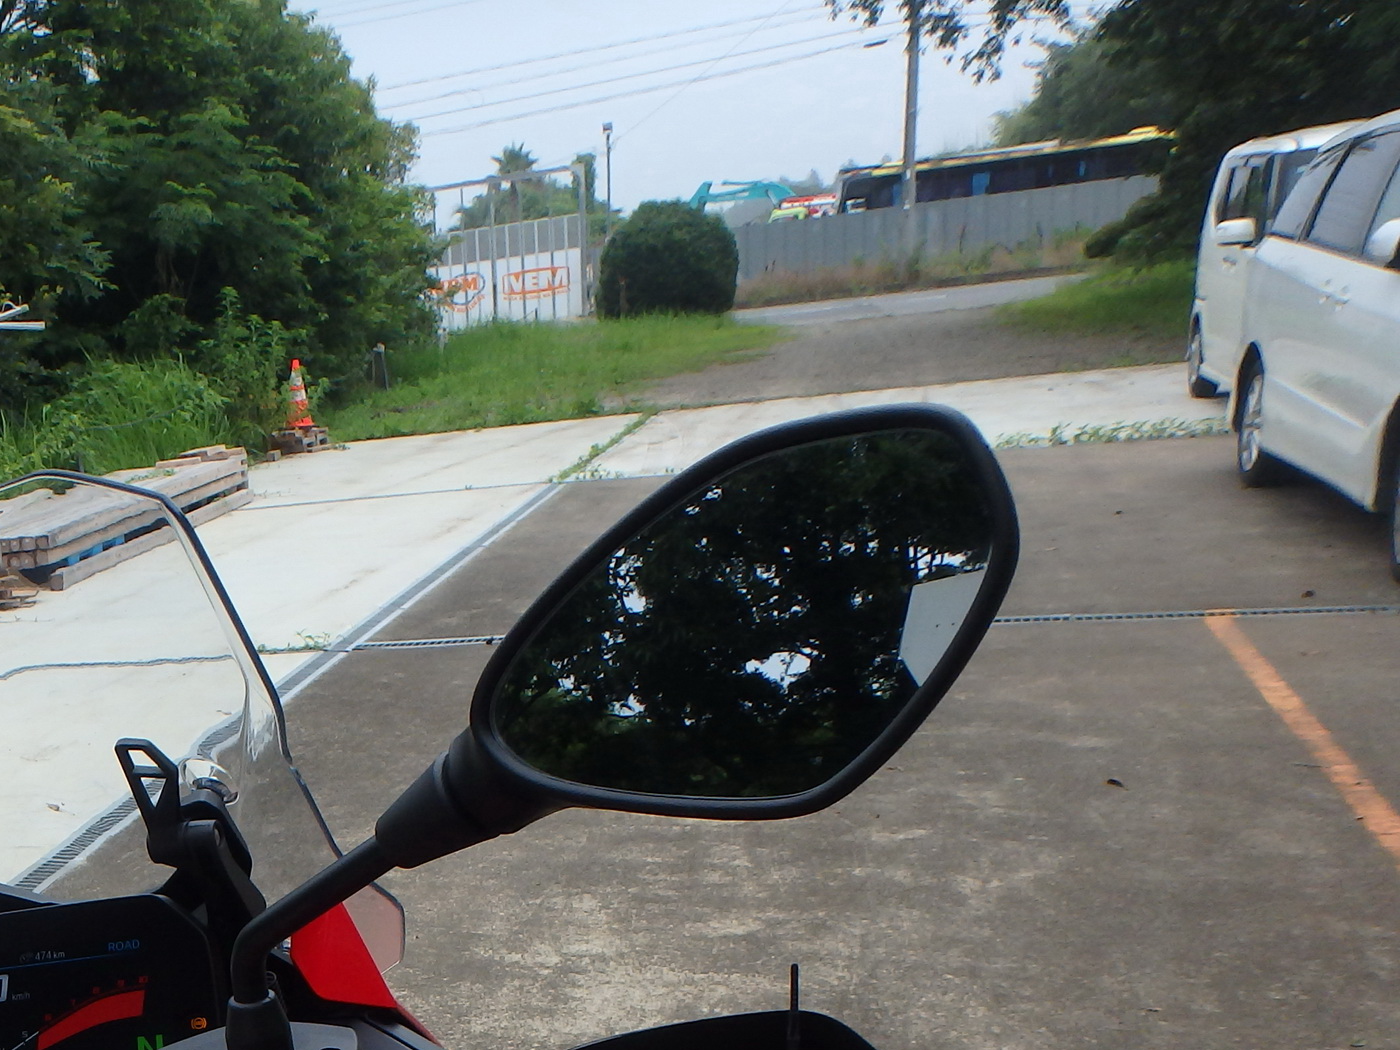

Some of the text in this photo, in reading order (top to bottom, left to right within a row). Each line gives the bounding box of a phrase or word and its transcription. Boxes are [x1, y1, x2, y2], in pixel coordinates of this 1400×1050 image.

[107, 939, 141, 951] ROAD
[35, 949, 66, 961] 474 km
[11, 992, 31, 1001] km/h
